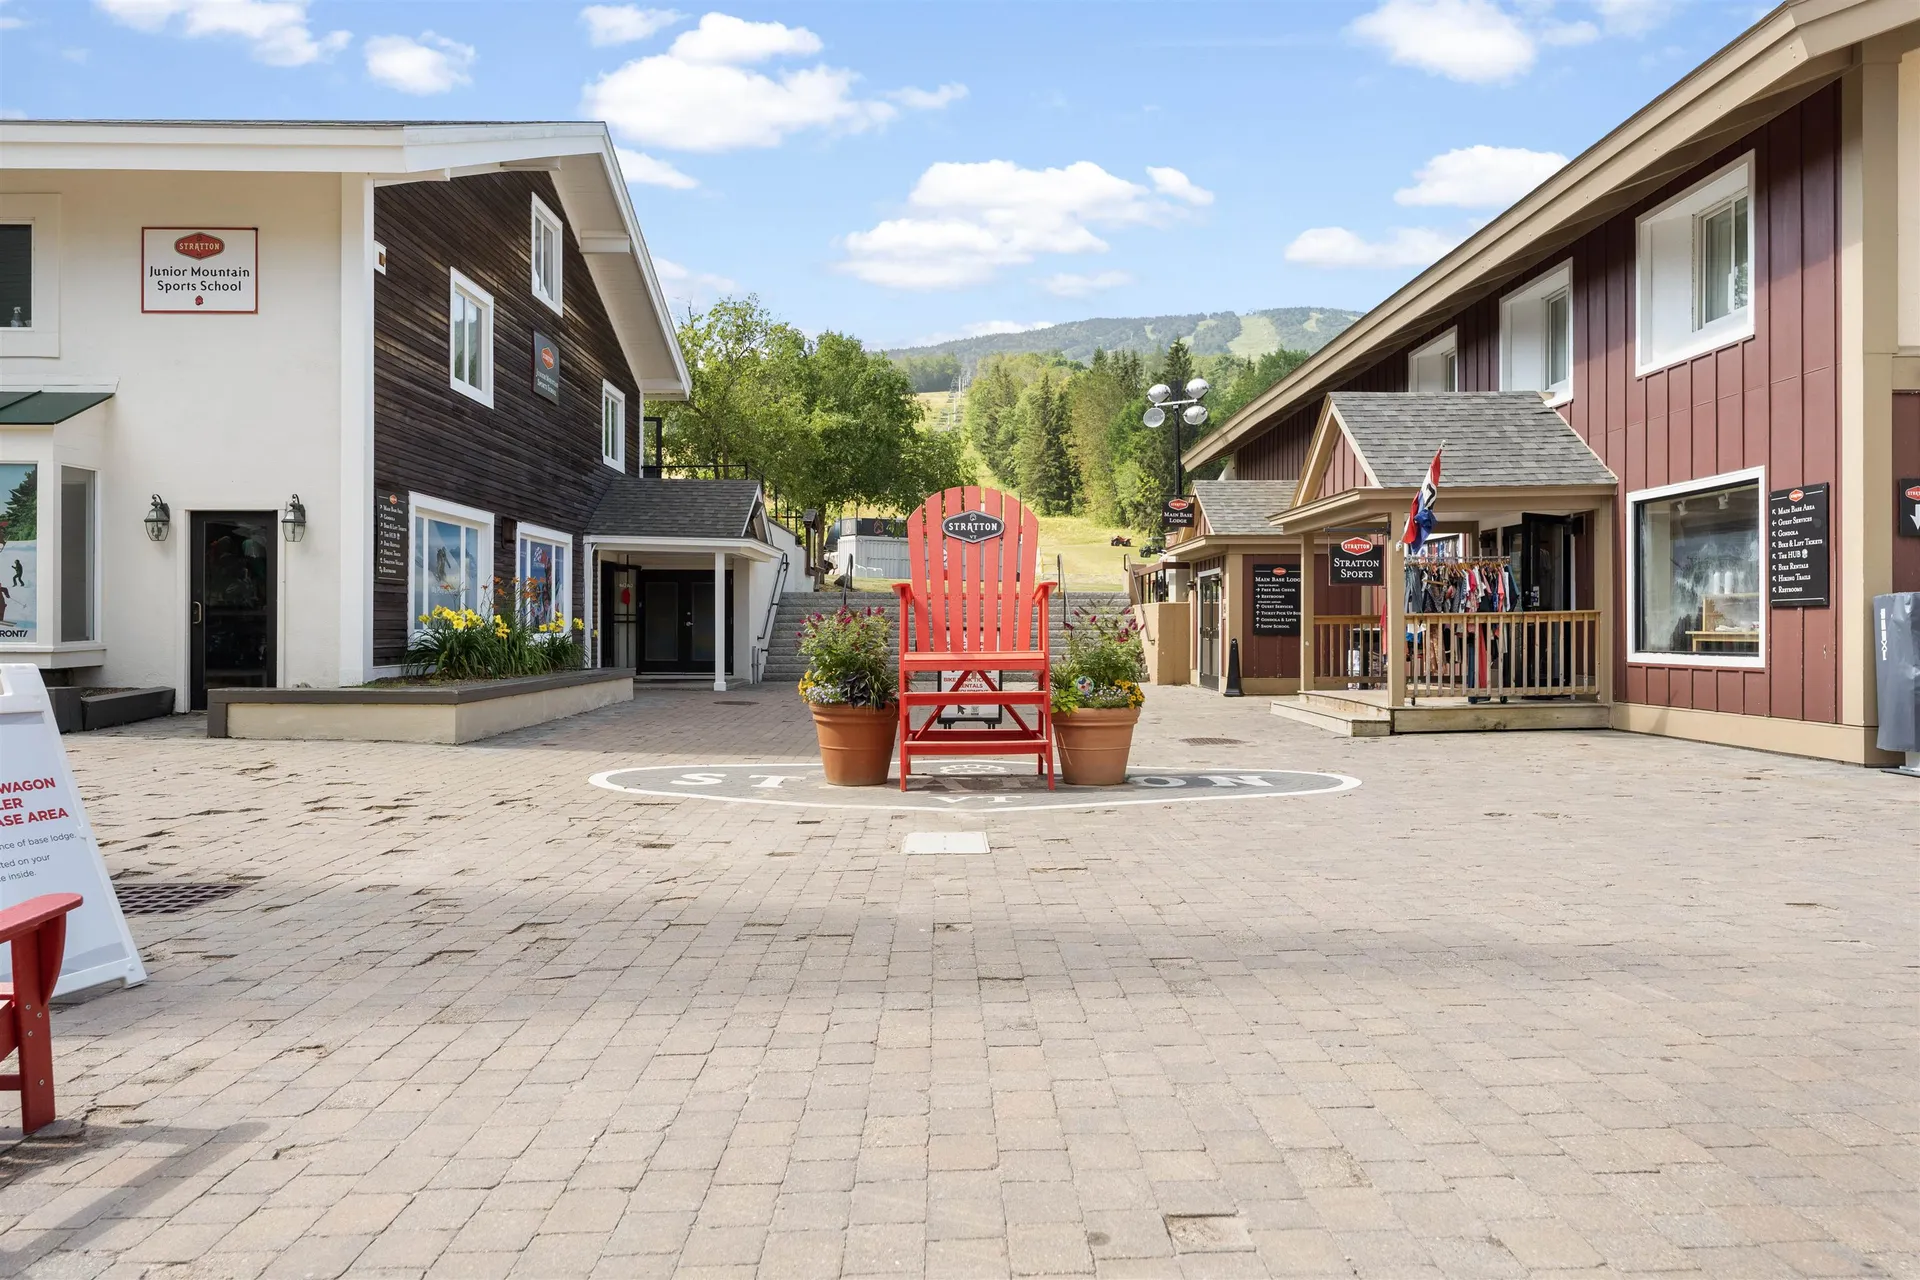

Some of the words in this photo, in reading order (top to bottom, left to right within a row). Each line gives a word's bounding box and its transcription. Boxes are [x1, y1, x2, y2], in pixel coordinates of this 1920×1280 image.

[179, 242, 221, 252] STRATTON
[149, 266, 187, 277] Junior
[191, 267, 250, 277] Mountain
[157, 280, 197, 293] Sports
[200, 280, 242, 291] School
[948, 522, 998, 533] STRATTON
[1333, 558, 1380, 567] STRATTON
[1340, 569, 1374, 578] SPORTS
[28, 808, 69, 823] AREA
[17, 839, 26, 847] of
[28, 836, 49, 846] base
[50, 832, 77, 842] lodge.
[17, 858, 30, 866] on
[31, 854, 50, 864] your
[8, 870, 37, 880] inside.
